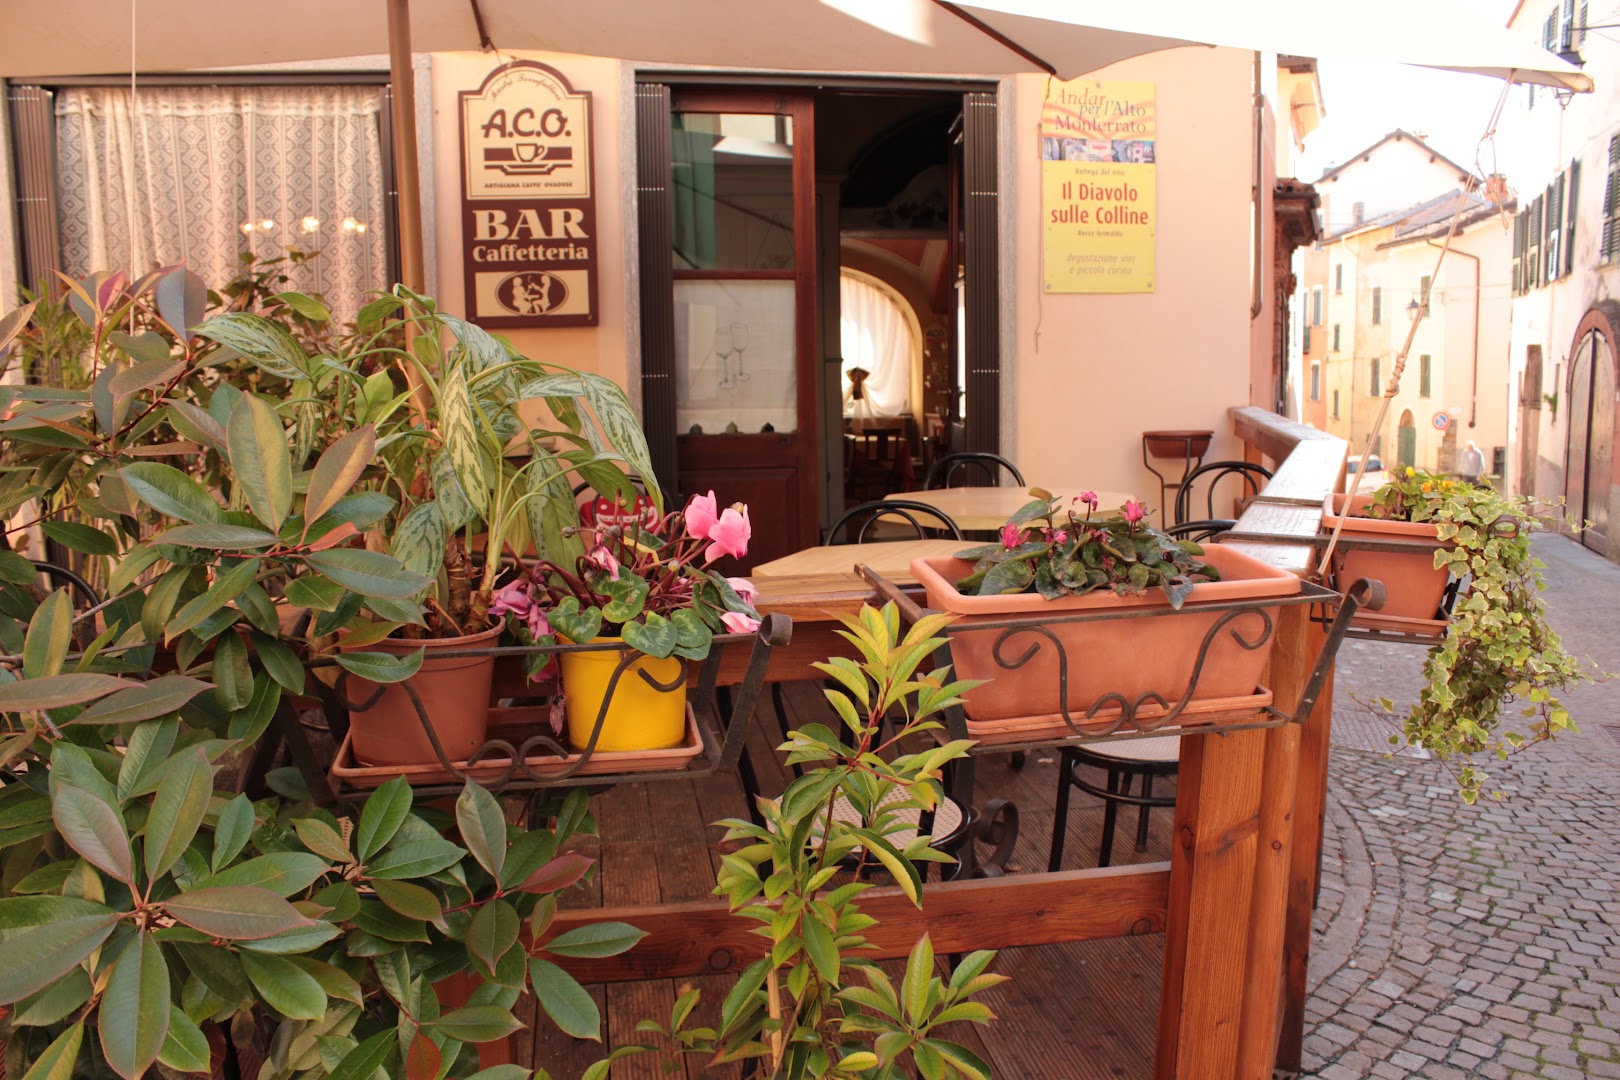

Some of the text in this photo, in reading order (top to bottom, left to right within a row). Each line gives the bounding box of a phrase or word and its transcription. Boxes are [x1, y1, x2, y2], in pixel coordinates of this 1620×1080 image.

[1055, 87, 1107, 105] Andar
[1079, 100, 1146, 120] per l'Alto
[481, 107, 572, 138] A.C.O.
[1055, 114, 1146, 133] Monferrato
[1075, 168, 1099, 176] Bottega
[1062, 181, 1138, 201] Il Diavolo
[472, 208, 589, 240] BAR
[1051, 204, 1149, 225] sulle Colline
[472, 243, 589, 262] Caffetteria
[1066, 253, 1136, 264] degustazione vini
[1077, 265, 1105, 276] piccola
[1107, 266, 1133, 274] cucina
